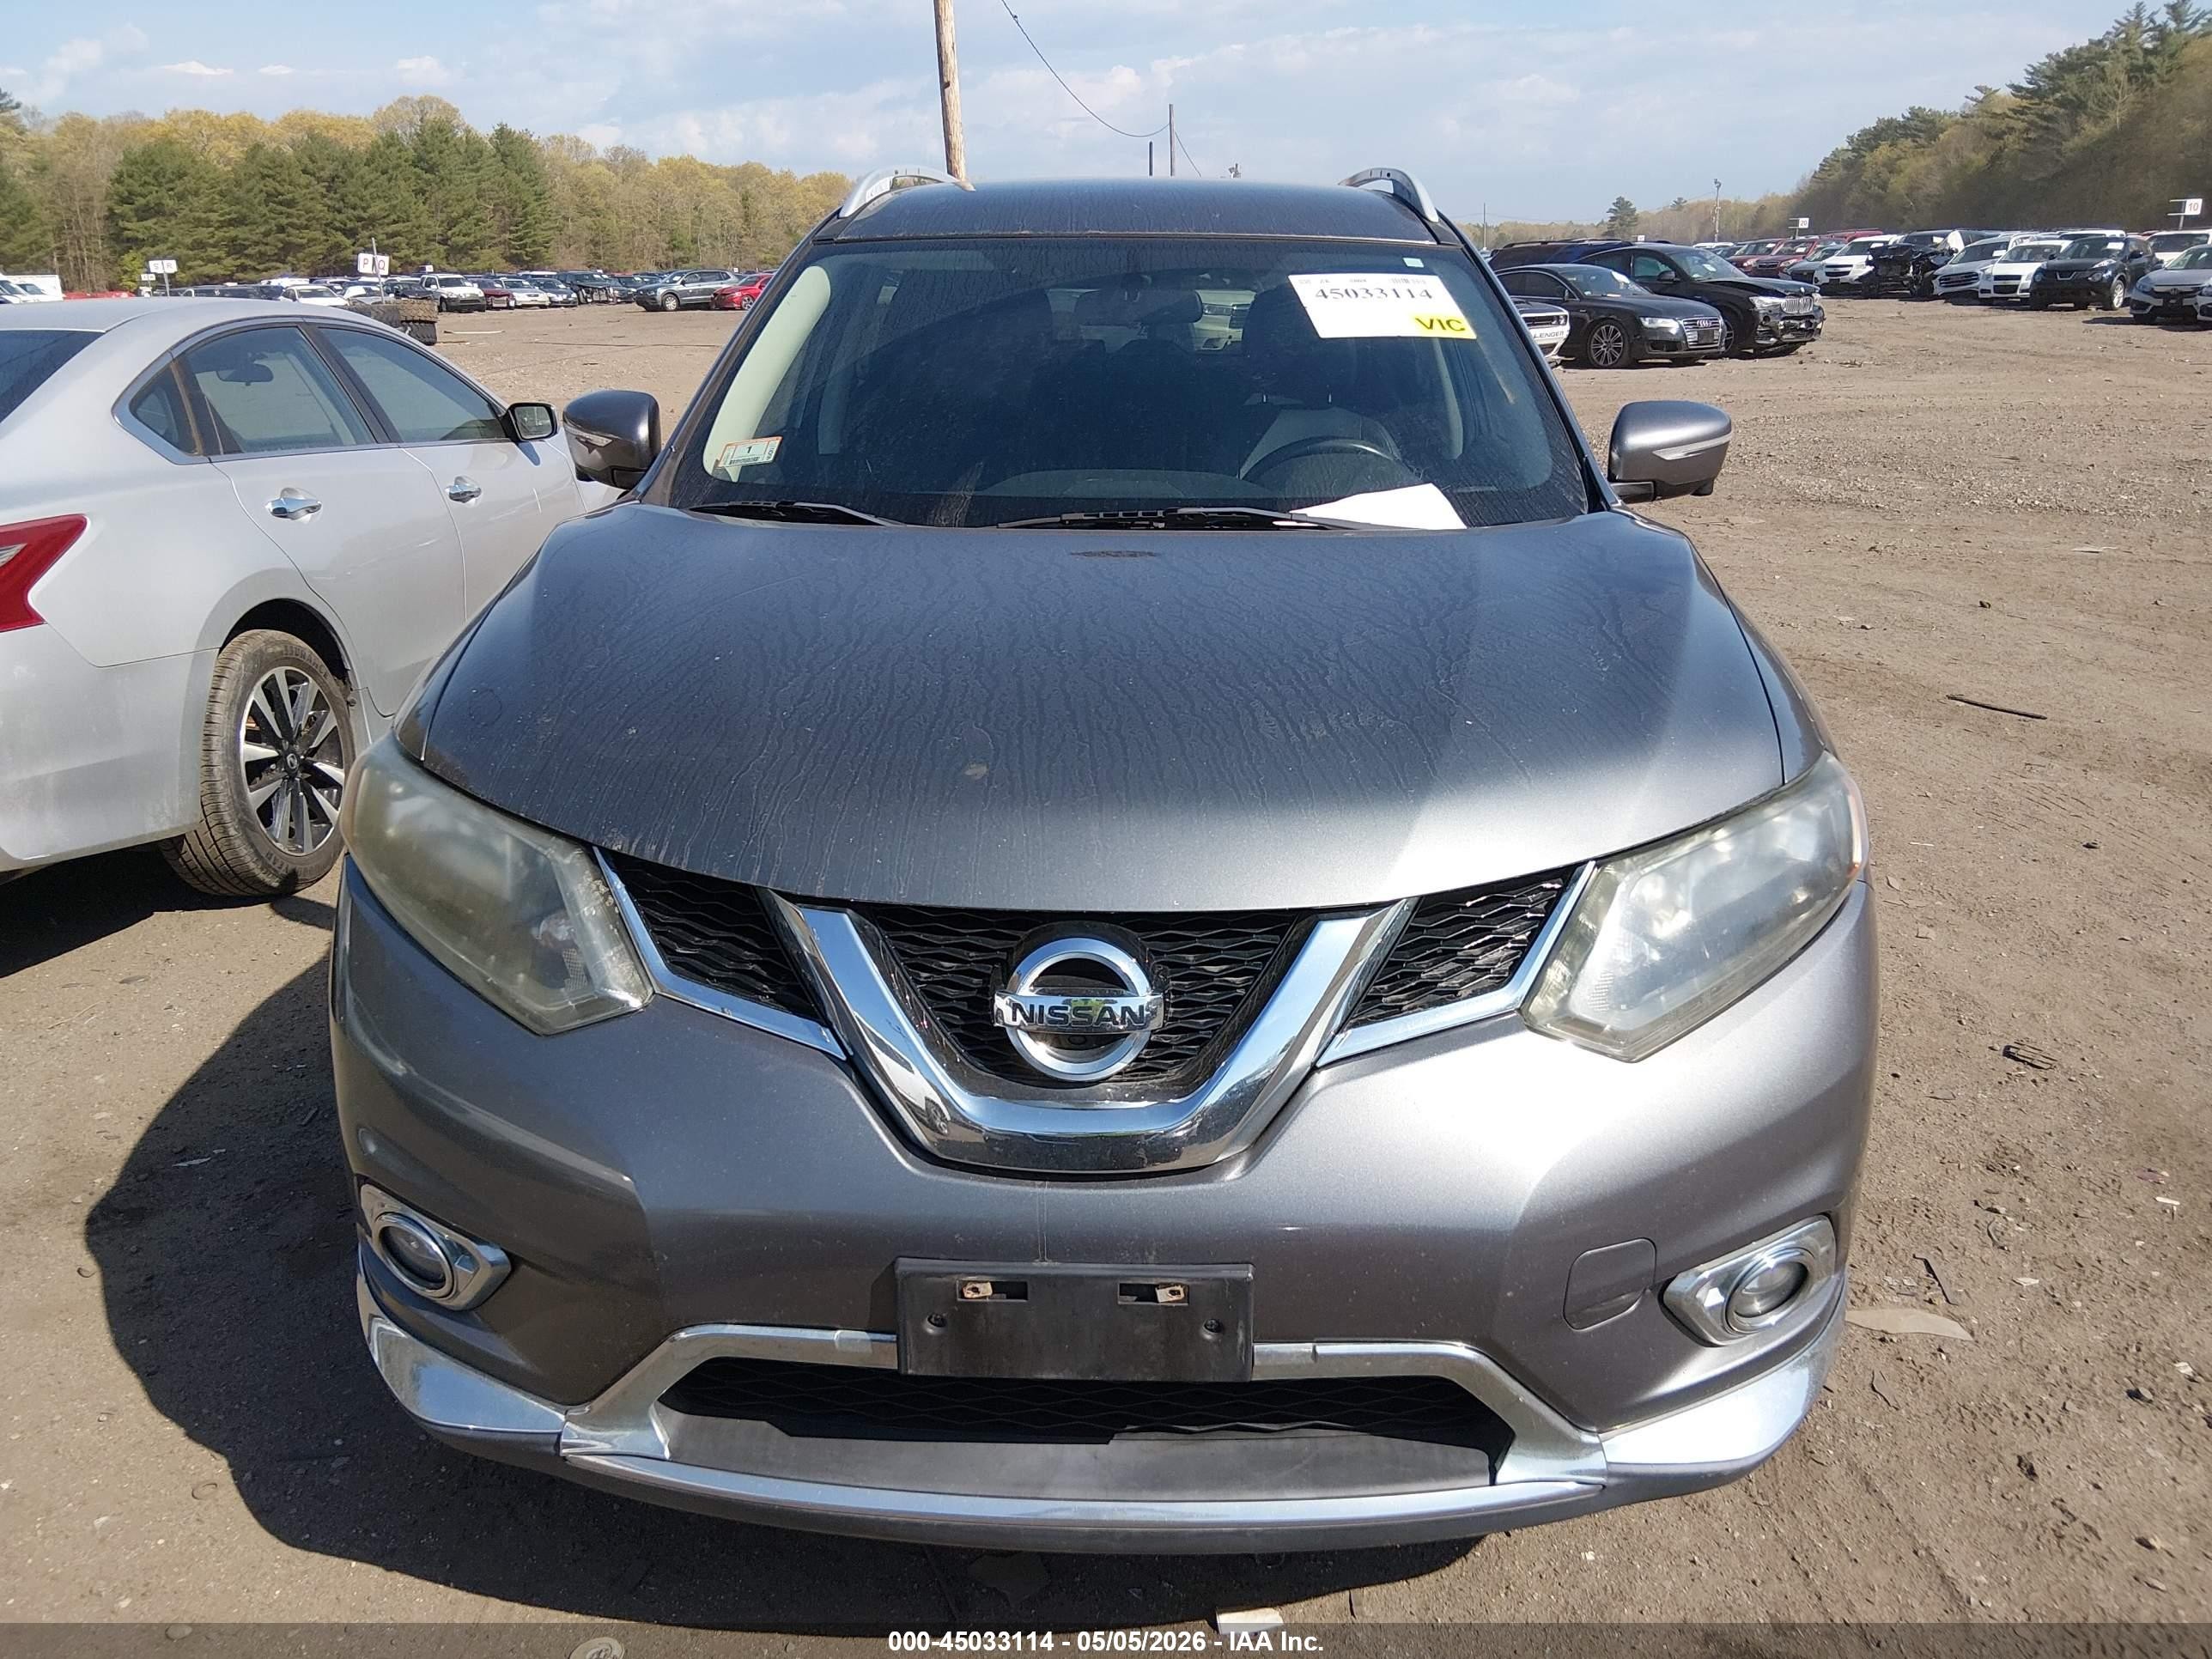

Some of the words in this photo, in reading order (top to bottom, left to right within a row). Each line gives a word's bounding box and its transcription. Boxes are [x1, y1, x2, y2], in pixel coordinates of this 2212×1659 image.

[2188, 202, 2199, 212] 10
[362, 258, 369, 269] P
[378, 259, 386, 270] Q
[1315, 288, 1433, 300] 45033114
[1415, 317, 1466, 331] VIC
[1012, 1002, 1145, 1027] NISSAN
